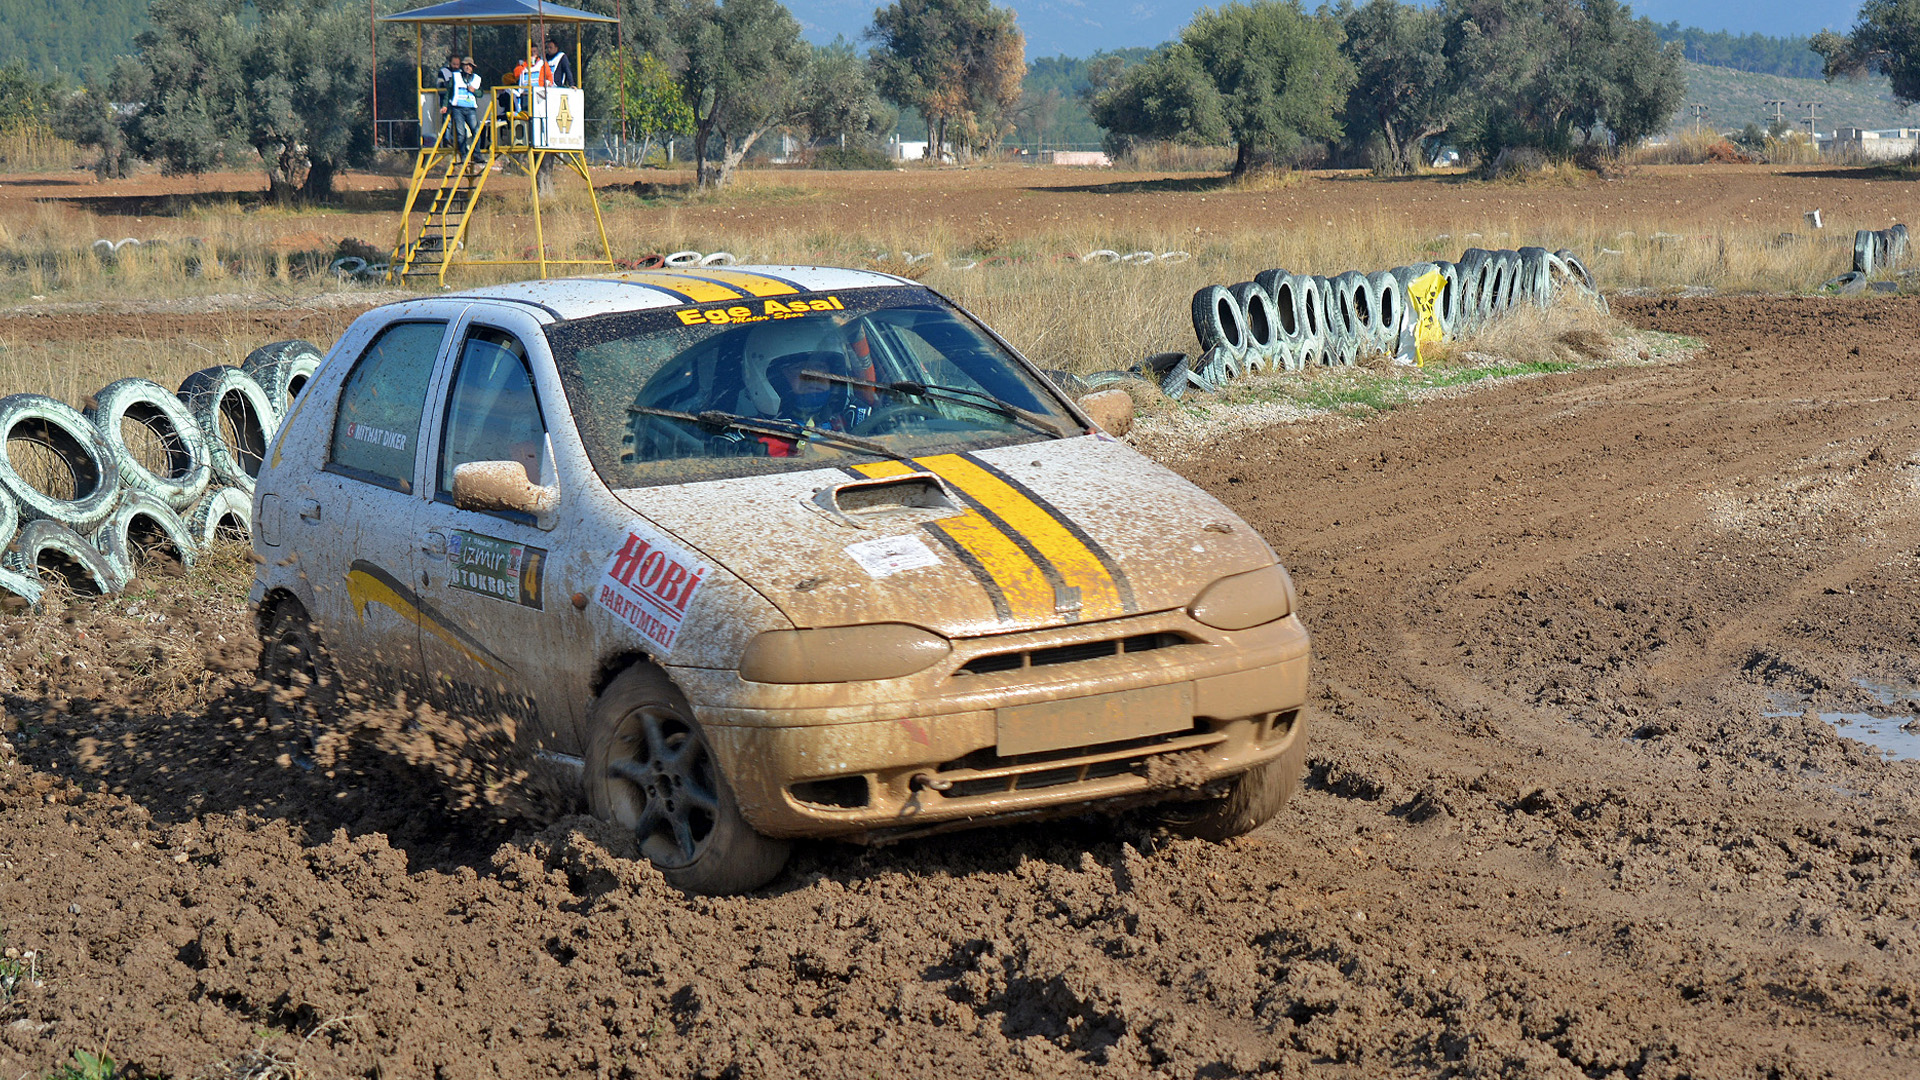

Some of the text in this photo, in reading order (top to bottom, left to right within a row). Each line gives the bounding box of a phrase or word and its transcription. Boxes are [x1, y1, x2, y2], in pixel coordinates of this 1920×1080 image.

[676, 296, 845, 326] Ege Asal
[730, 312, 805, 324] Motor Spor
[524, 554, 541, 600] 4
[608, 532, 705, 613] HOBİ
[599, 584, 677, 649] PARFÜMERİ
